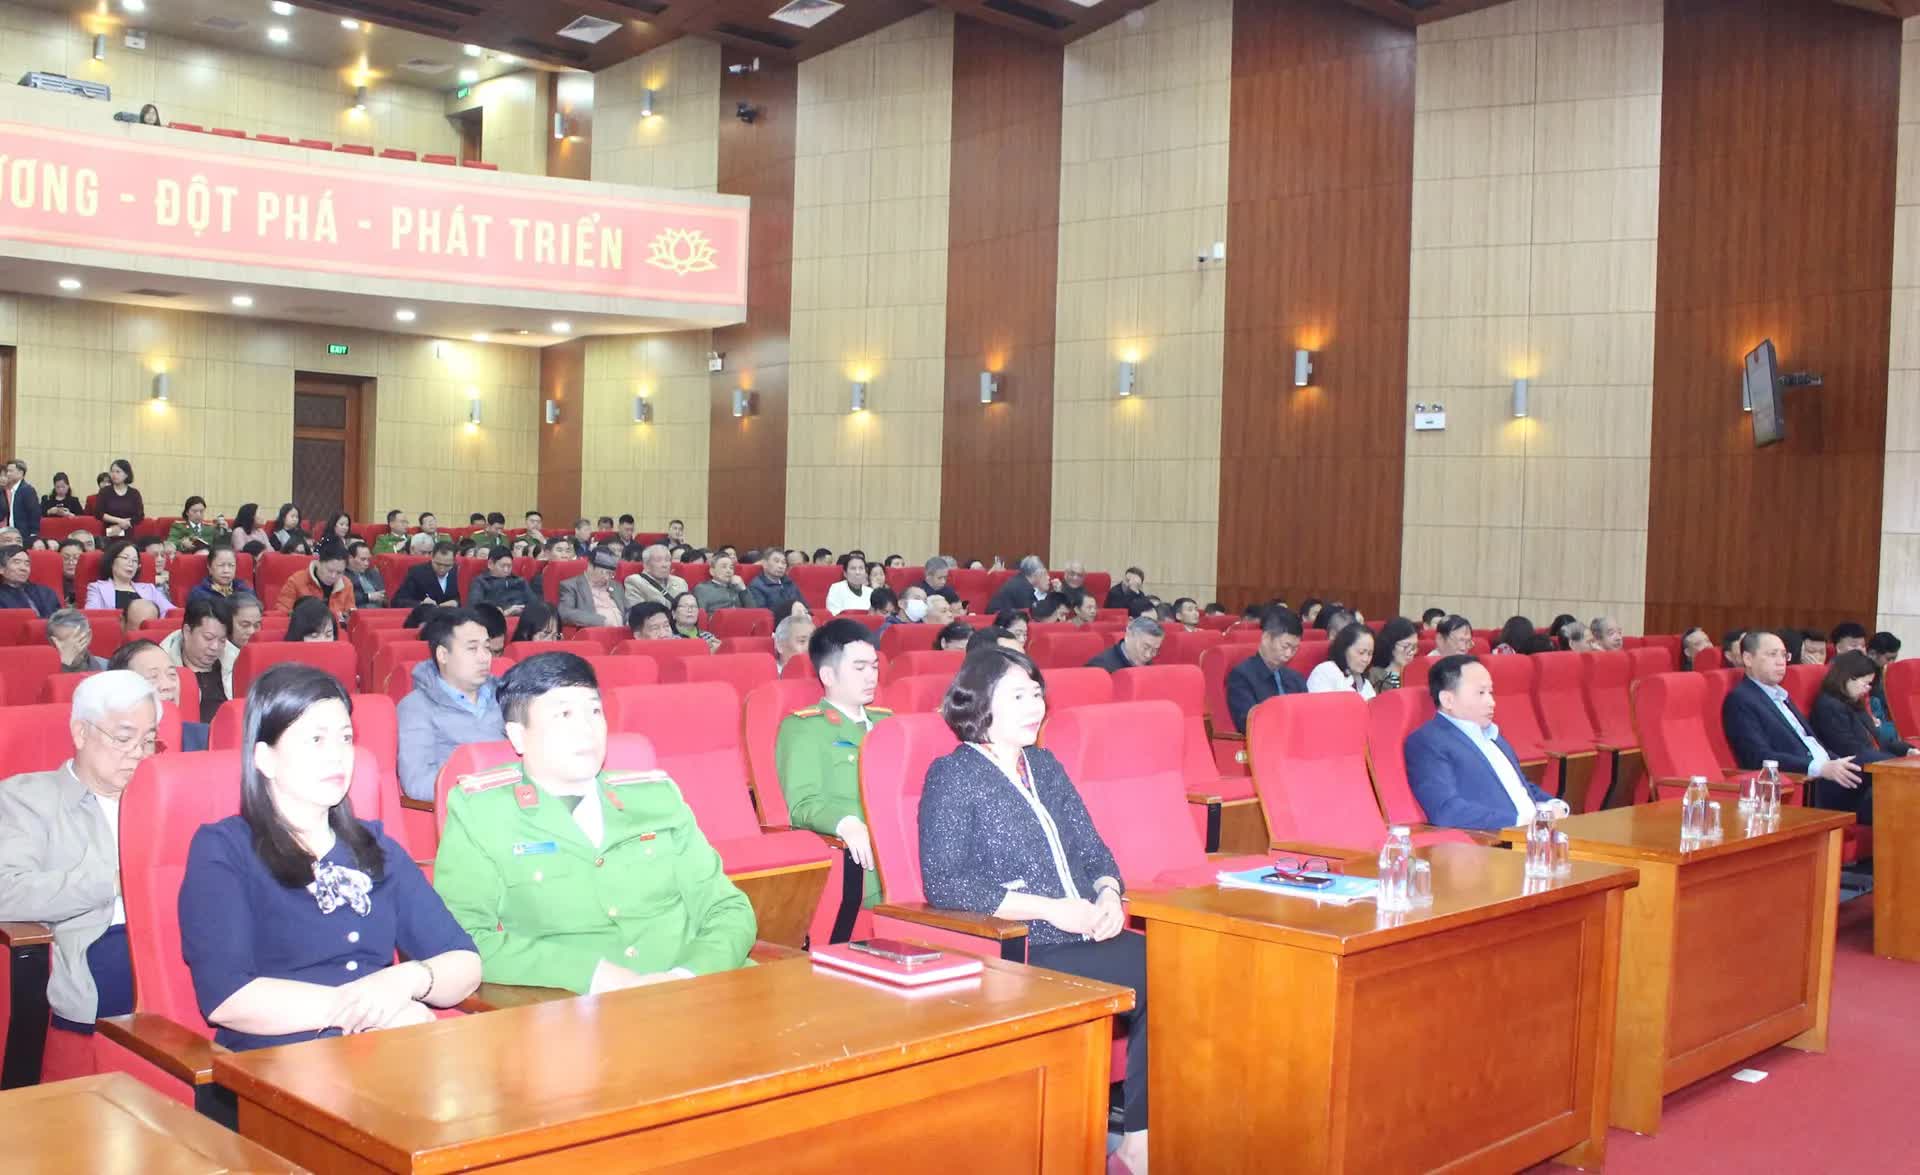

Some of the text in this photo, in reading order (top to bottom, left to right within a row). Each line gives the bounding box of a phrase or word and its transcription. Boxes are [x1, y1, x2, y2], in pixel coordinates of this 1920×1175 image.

[0, 154, 99, 217] ƠNG
[153, 175, 239, 238] ĐỘT
[257, 190, 338, 244] PHÁ
[391, 203, 493, 258] PHÁT
[509, 212, 623, 270] TRIỂN
